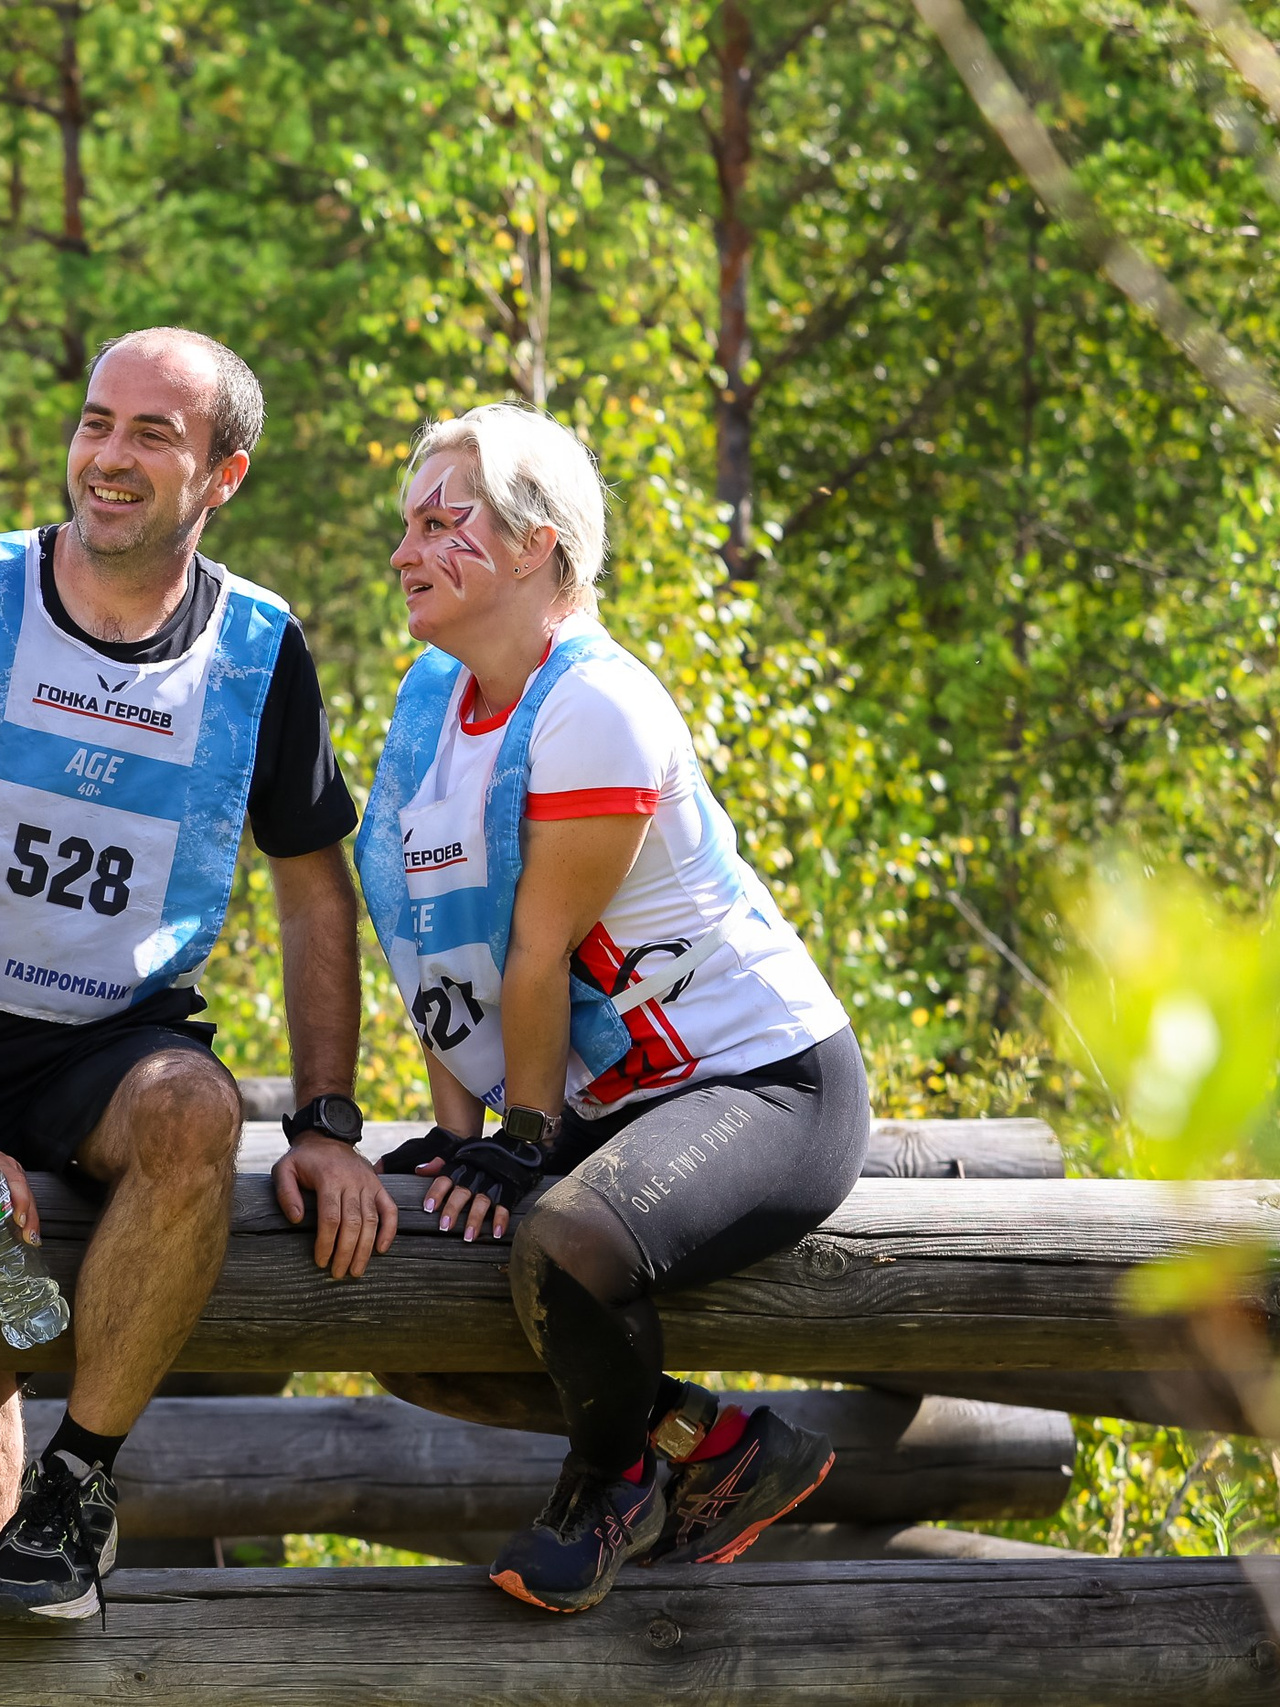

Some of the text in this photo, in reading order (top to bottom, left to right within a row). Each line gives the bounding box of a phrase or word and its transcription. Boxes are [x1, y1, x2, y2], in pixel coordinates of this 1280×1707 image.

[37, 683, 173, 728] ГОНКА ГЕРОЕВ
[65, 748, 125, 785] AGE
[78, 782, 102, 797] 40+
[6, 822, 135, 917] 528
[404, 842, 463, 867] ГЕРОЕВ
[4, 958, 131, 1000] ГАЗПРОМБАНК
[631, 1104, 752, 1213] ONE-TWO PUNCH
